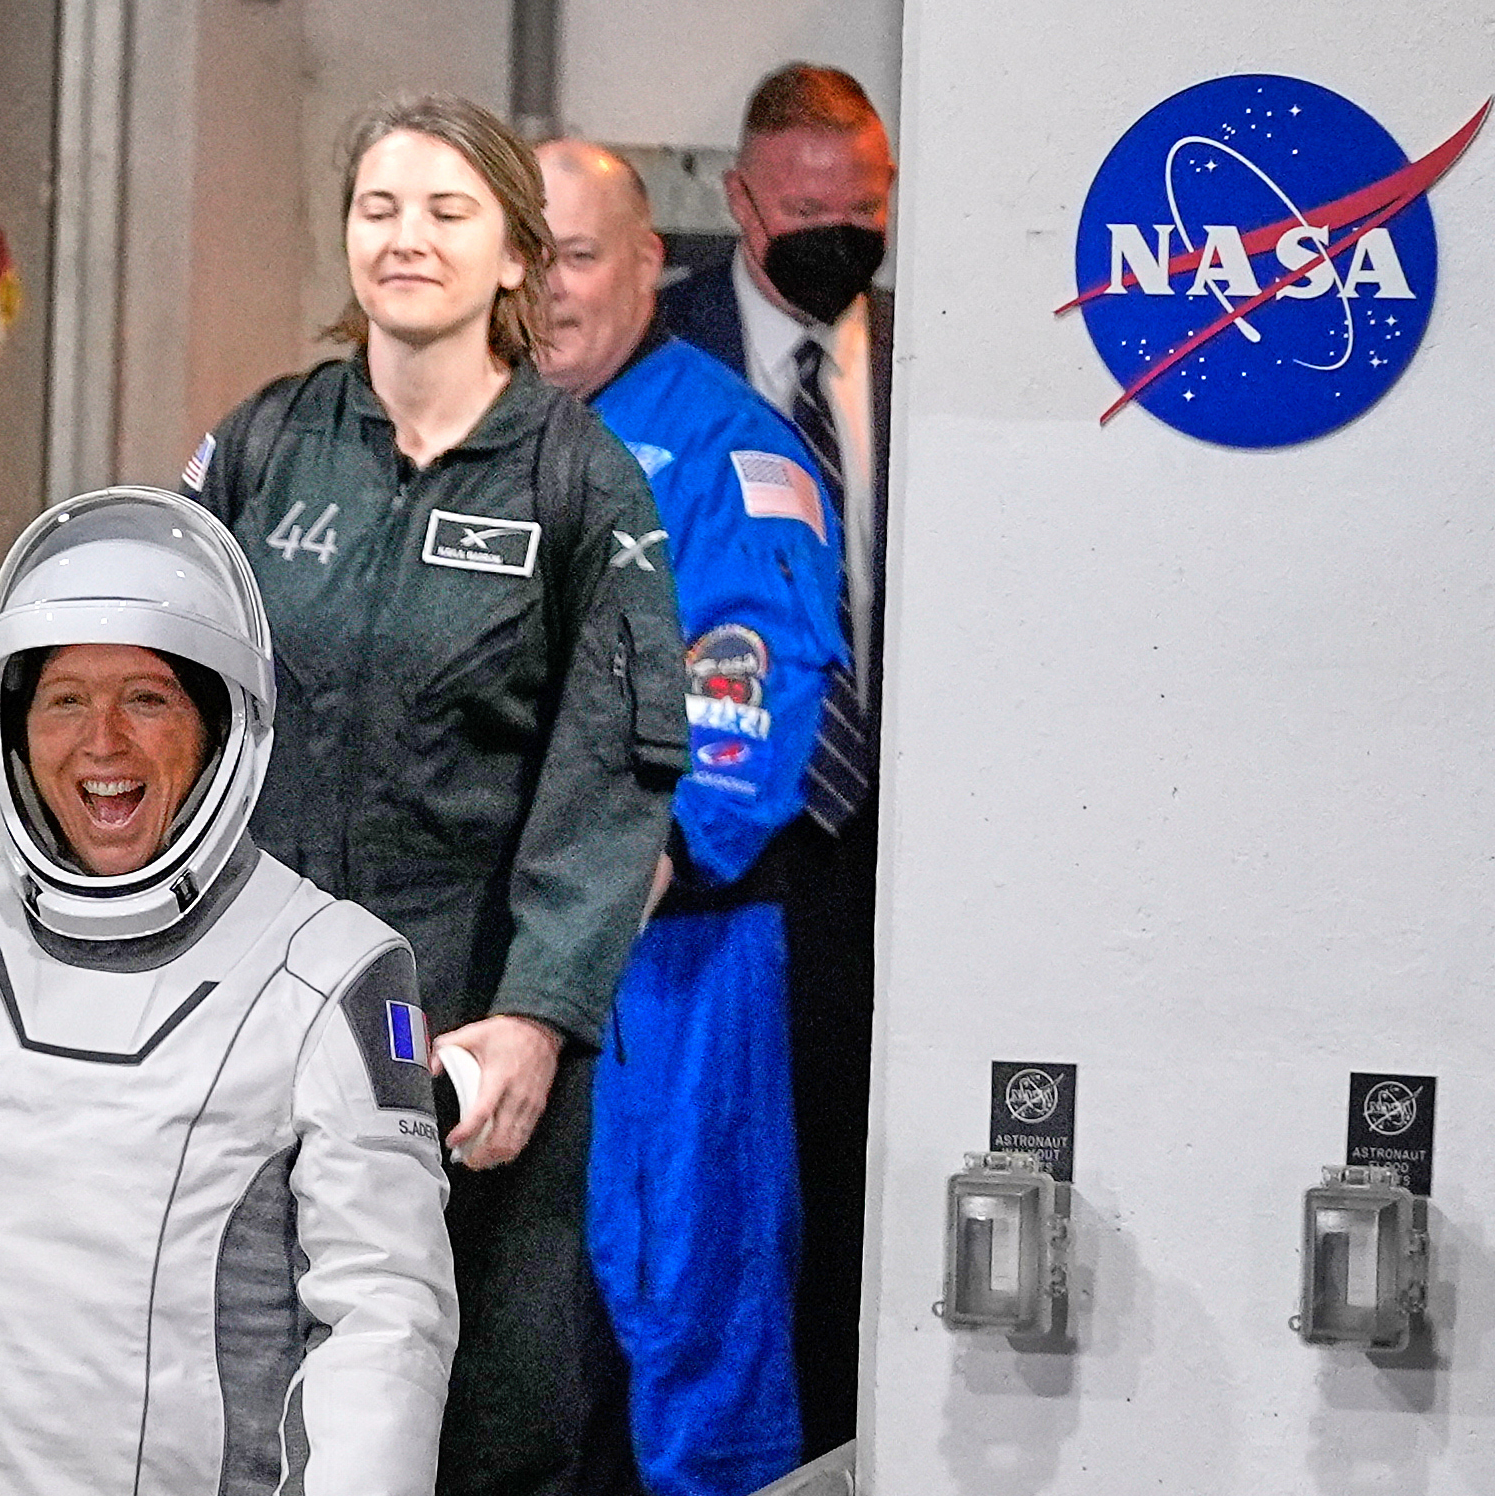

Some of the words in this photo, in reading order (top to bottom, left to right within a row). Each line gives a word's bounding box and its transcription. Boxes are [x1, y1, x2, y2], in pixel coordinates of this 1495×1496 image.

[1105, 223, 1417, 300] NASA
[265, 500, 341, 564] 44
[994, 1134, 1069, 1149] ASTRONAUT
[1351, 1146, 1427, 1161] ASTRONAUT
